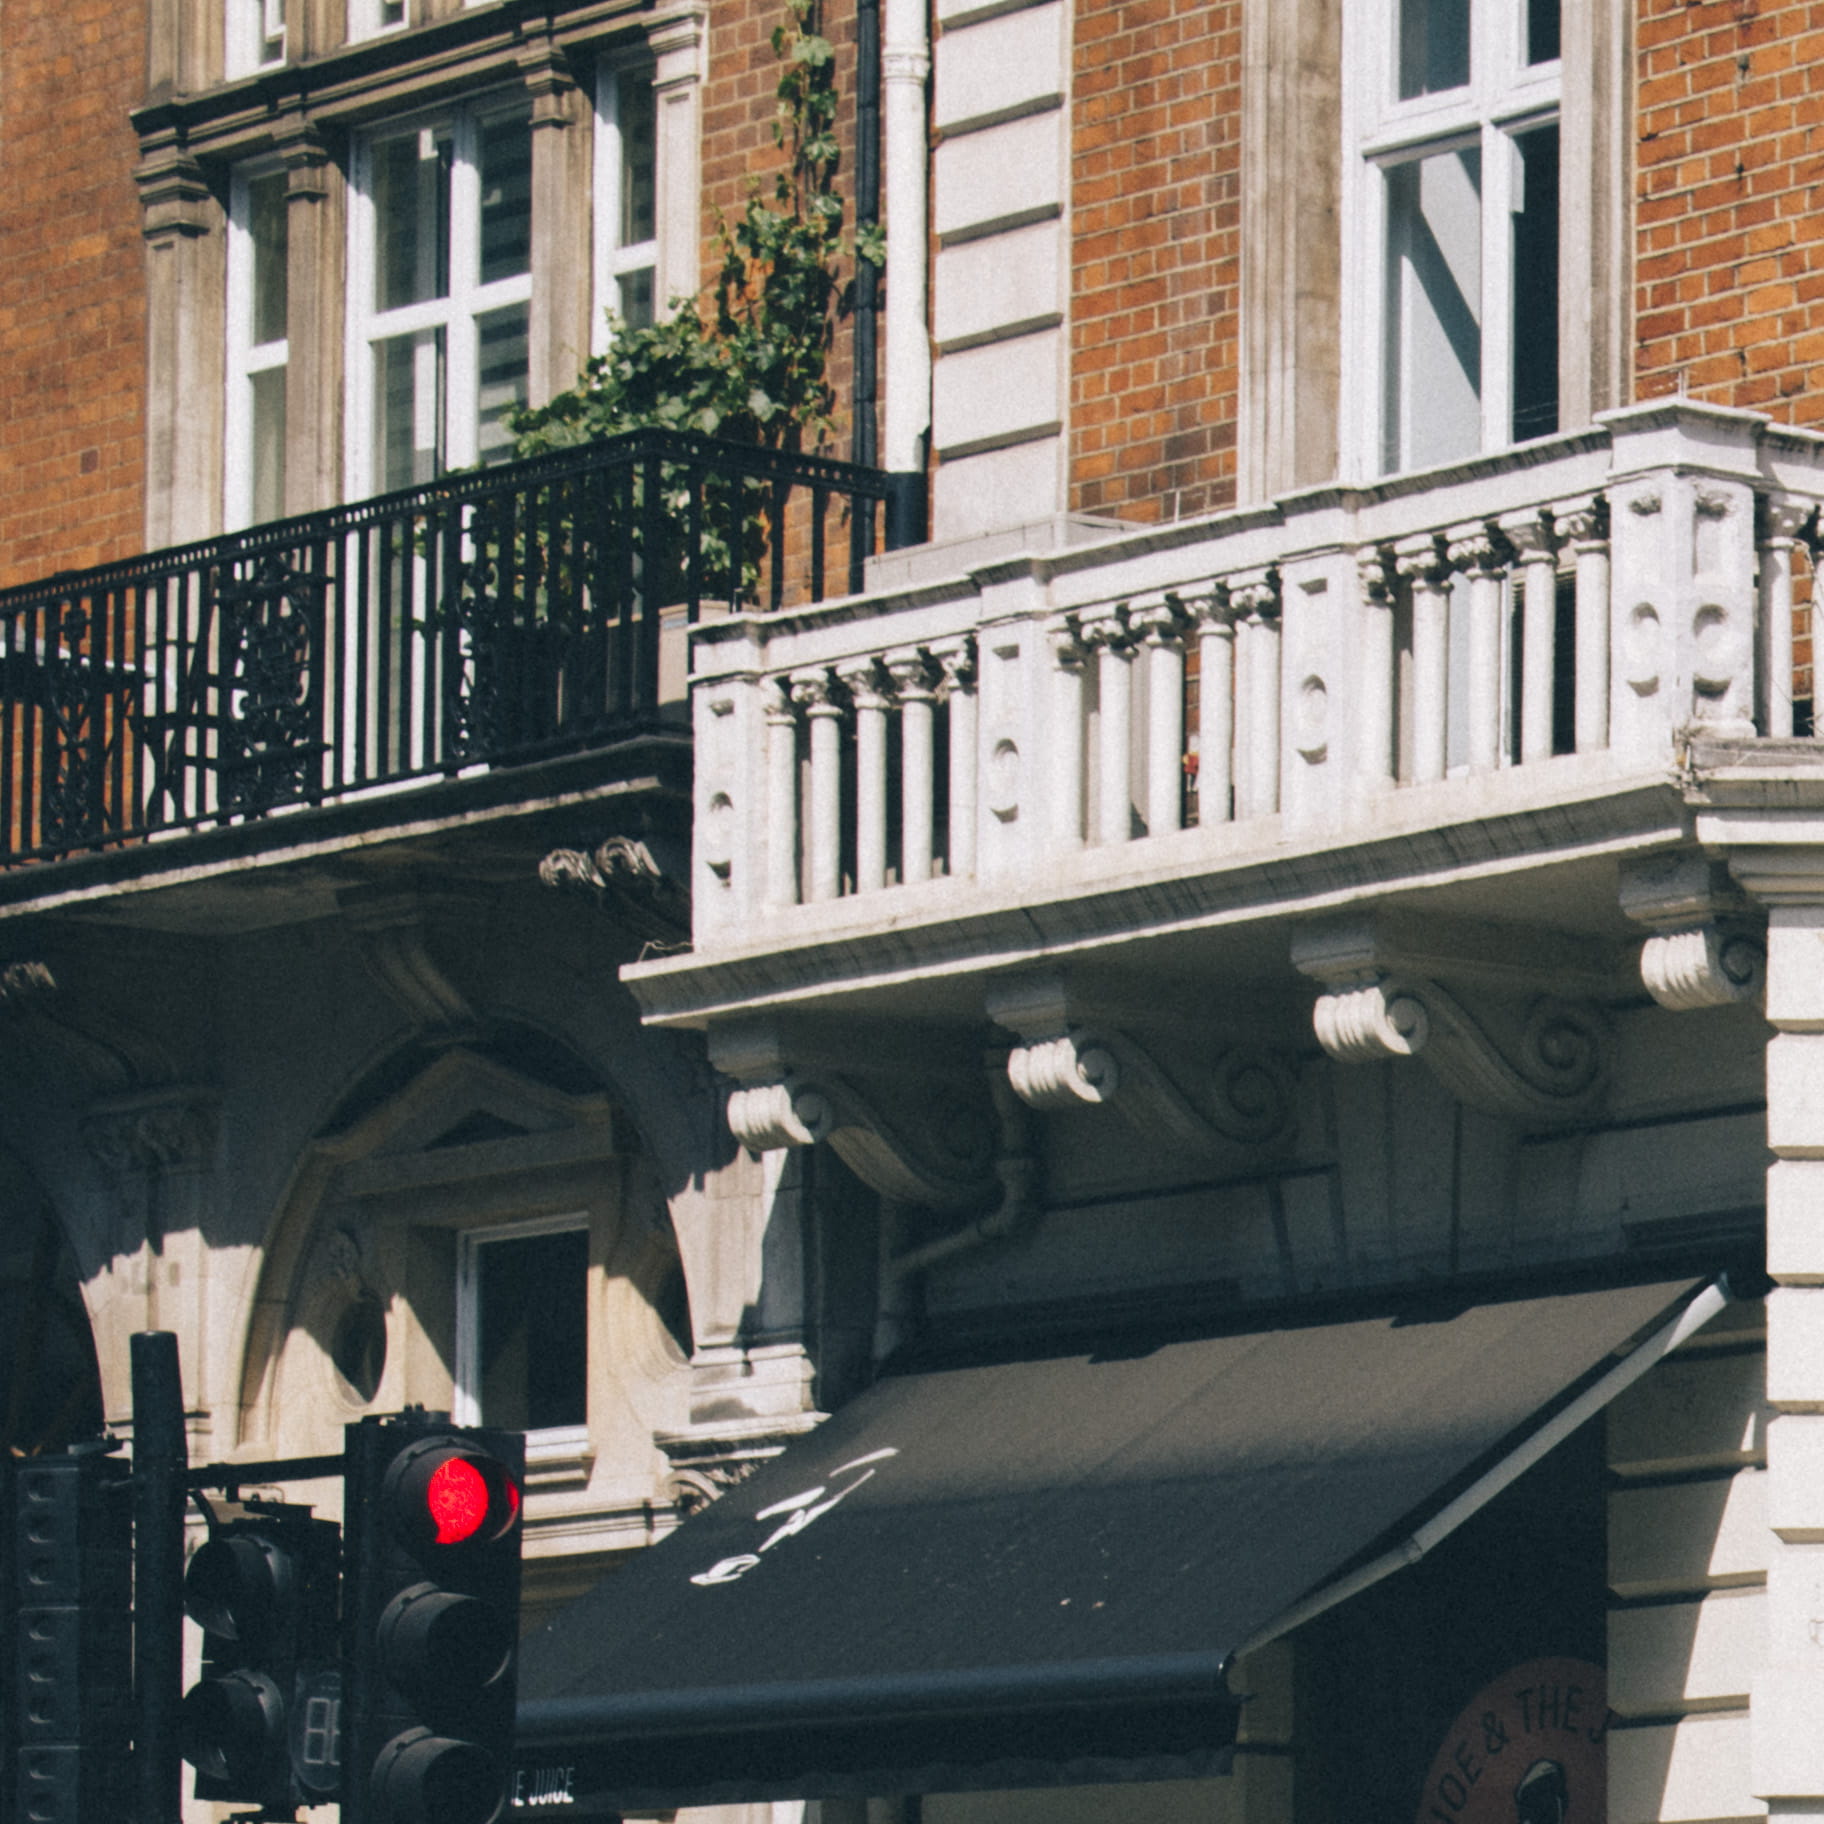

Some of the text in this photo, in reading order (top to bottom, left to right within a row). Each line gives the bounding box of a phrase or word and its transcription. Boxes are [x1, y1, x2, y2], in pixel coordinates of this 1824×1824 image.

[1480, 1710, 1510, 1755] &
[1514, 1683, 1584, 1733] THE
[528, 1767, 575, 1806] JUICE
